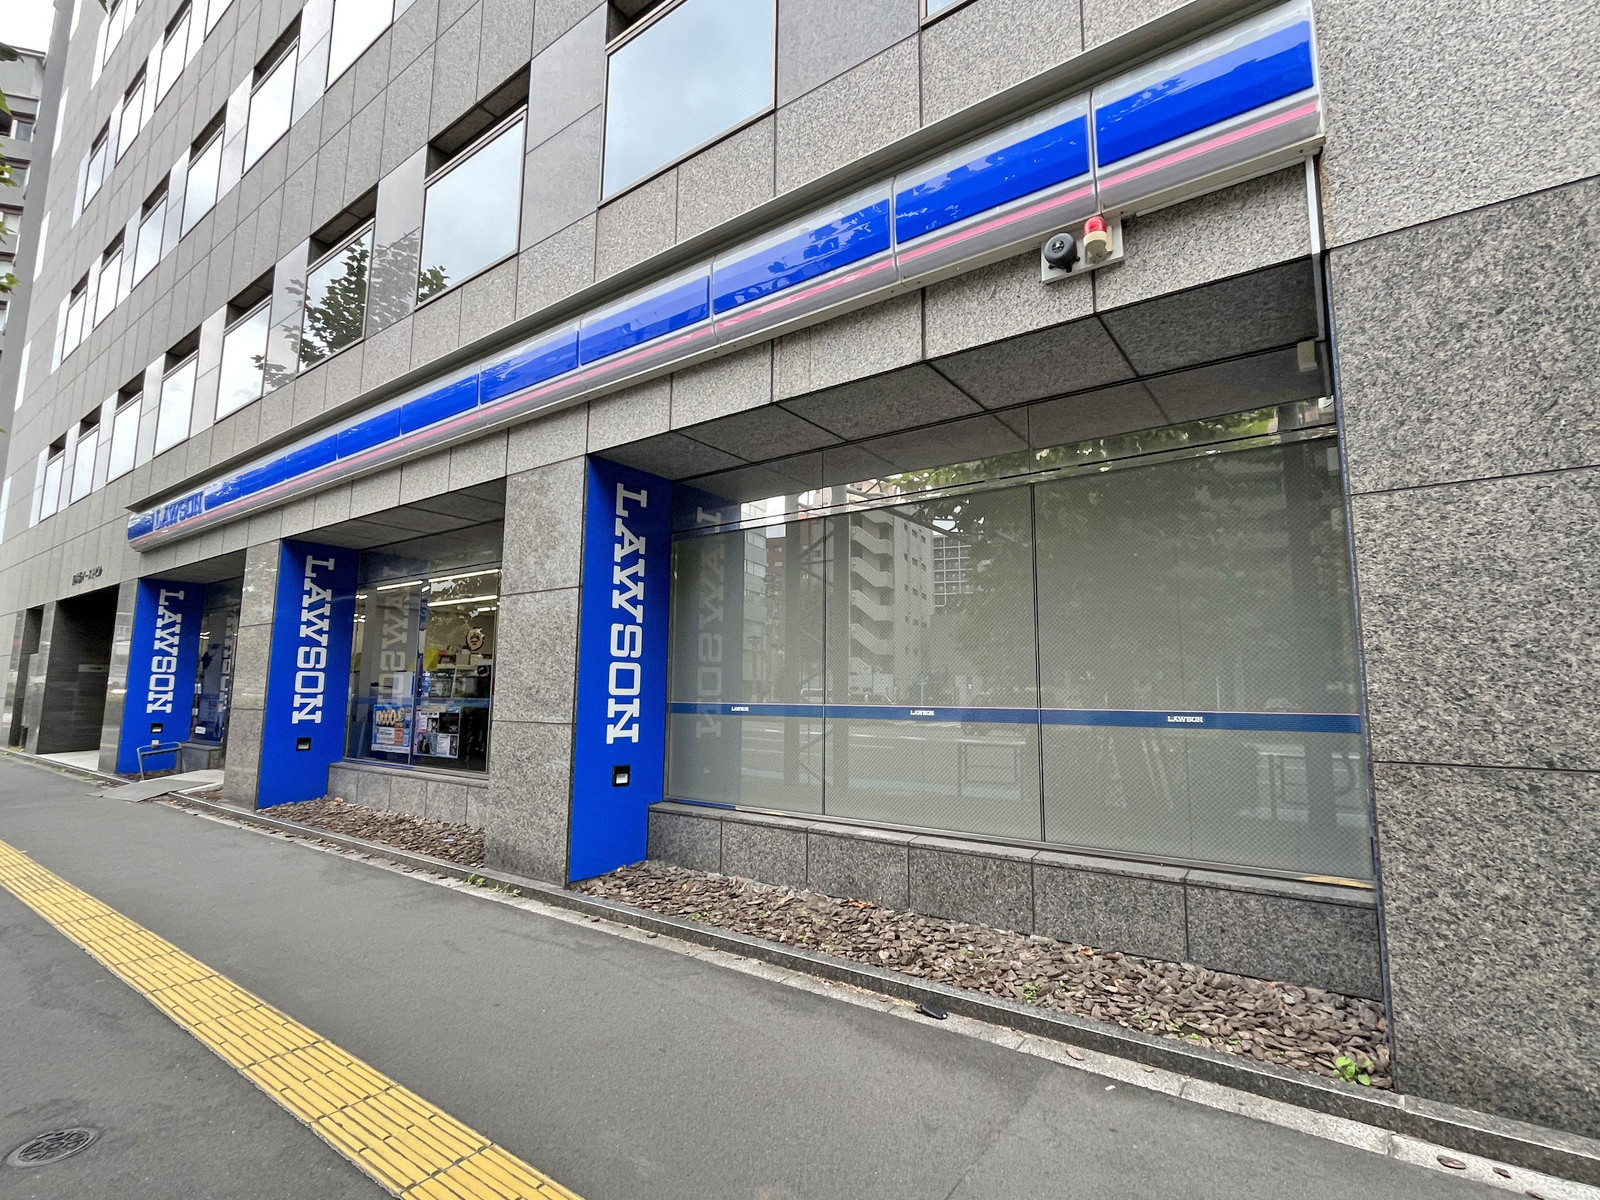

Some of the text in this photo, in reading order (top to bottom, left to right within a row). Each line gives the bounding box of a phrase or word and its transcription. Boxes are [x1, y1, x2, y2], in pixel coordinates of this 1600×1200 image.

[155, 491, 204, 530] LAWSON
[145, 588, 184, 714] LAWSON
[291, 555, 335, 725] LAWSON
[605, 482, 647, 745] LAWSON
[1167, 715, 1204, 723] LAWSON
